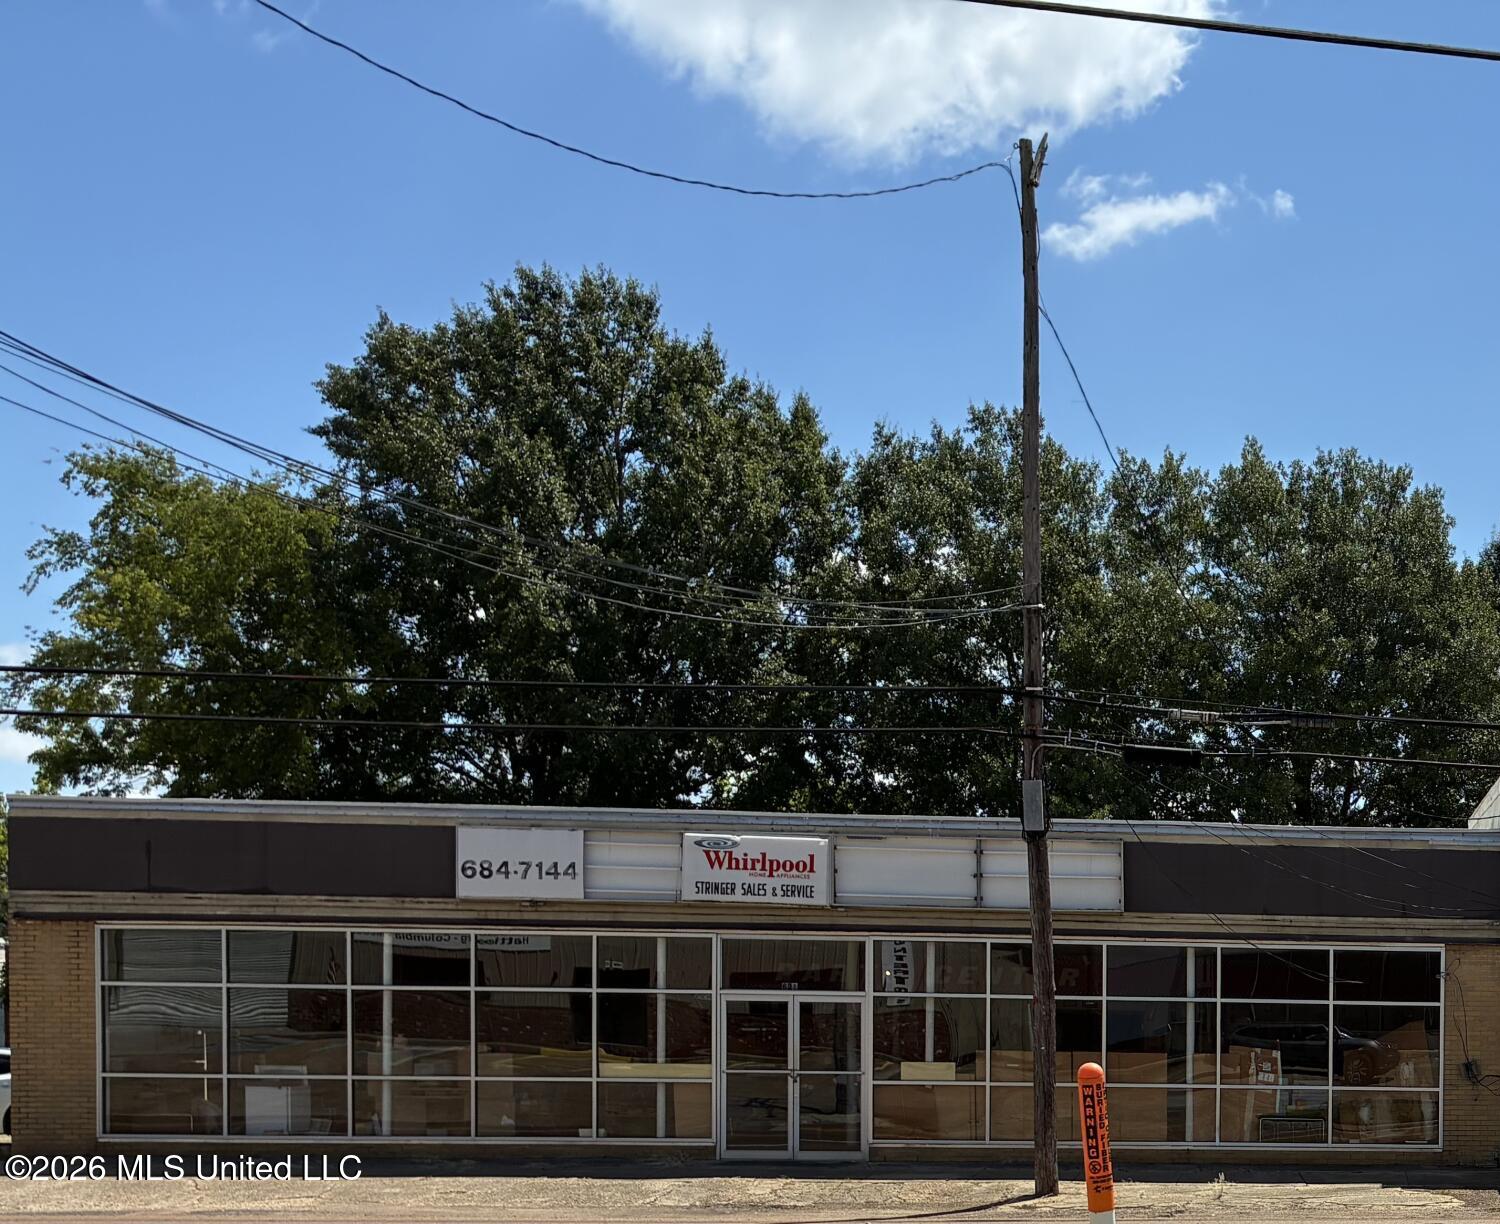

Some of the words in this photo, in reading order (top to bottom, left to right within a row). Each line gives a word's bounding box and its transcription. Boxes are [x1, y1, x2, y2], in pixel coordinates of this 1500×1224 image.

[703, 849, 816, 878] Whirlpool
[695, 881, 736, 896] STRINGER
[741, 882, 767, 897] SALES
[772, 886, 778, 897] &
[781, 884, 815, 899] SERVICE
[1083, 1087, 1098, 1157] WARNING
[1095, 1083, 1105, 1130] BURIED
[1100, 1133, 1109, 1172] FIBER
